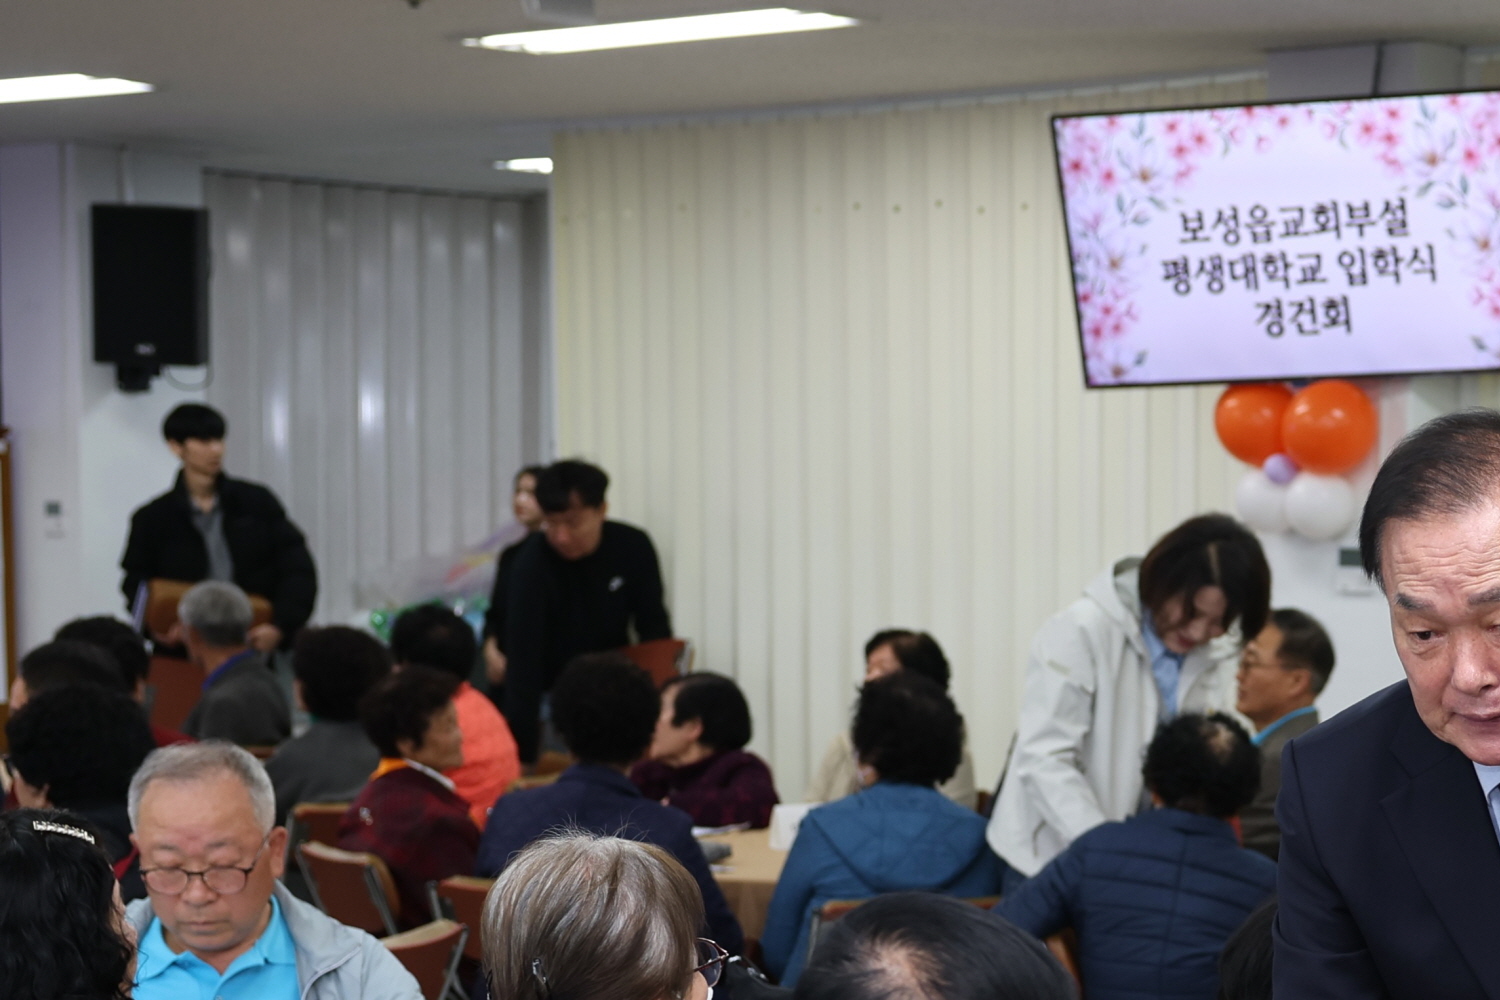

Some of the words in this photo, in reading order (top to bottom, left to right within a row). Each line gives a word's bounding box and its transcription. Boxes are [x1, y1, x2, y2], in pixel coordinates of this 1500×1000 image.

[1179, 197, 1410, 246] 보성읍교회부설
[1161, 251, 1328, 296] 평생대학교
[1337, 243, 1437, 287] 입학식
[1255, 295, 1353, 338] 경건회
